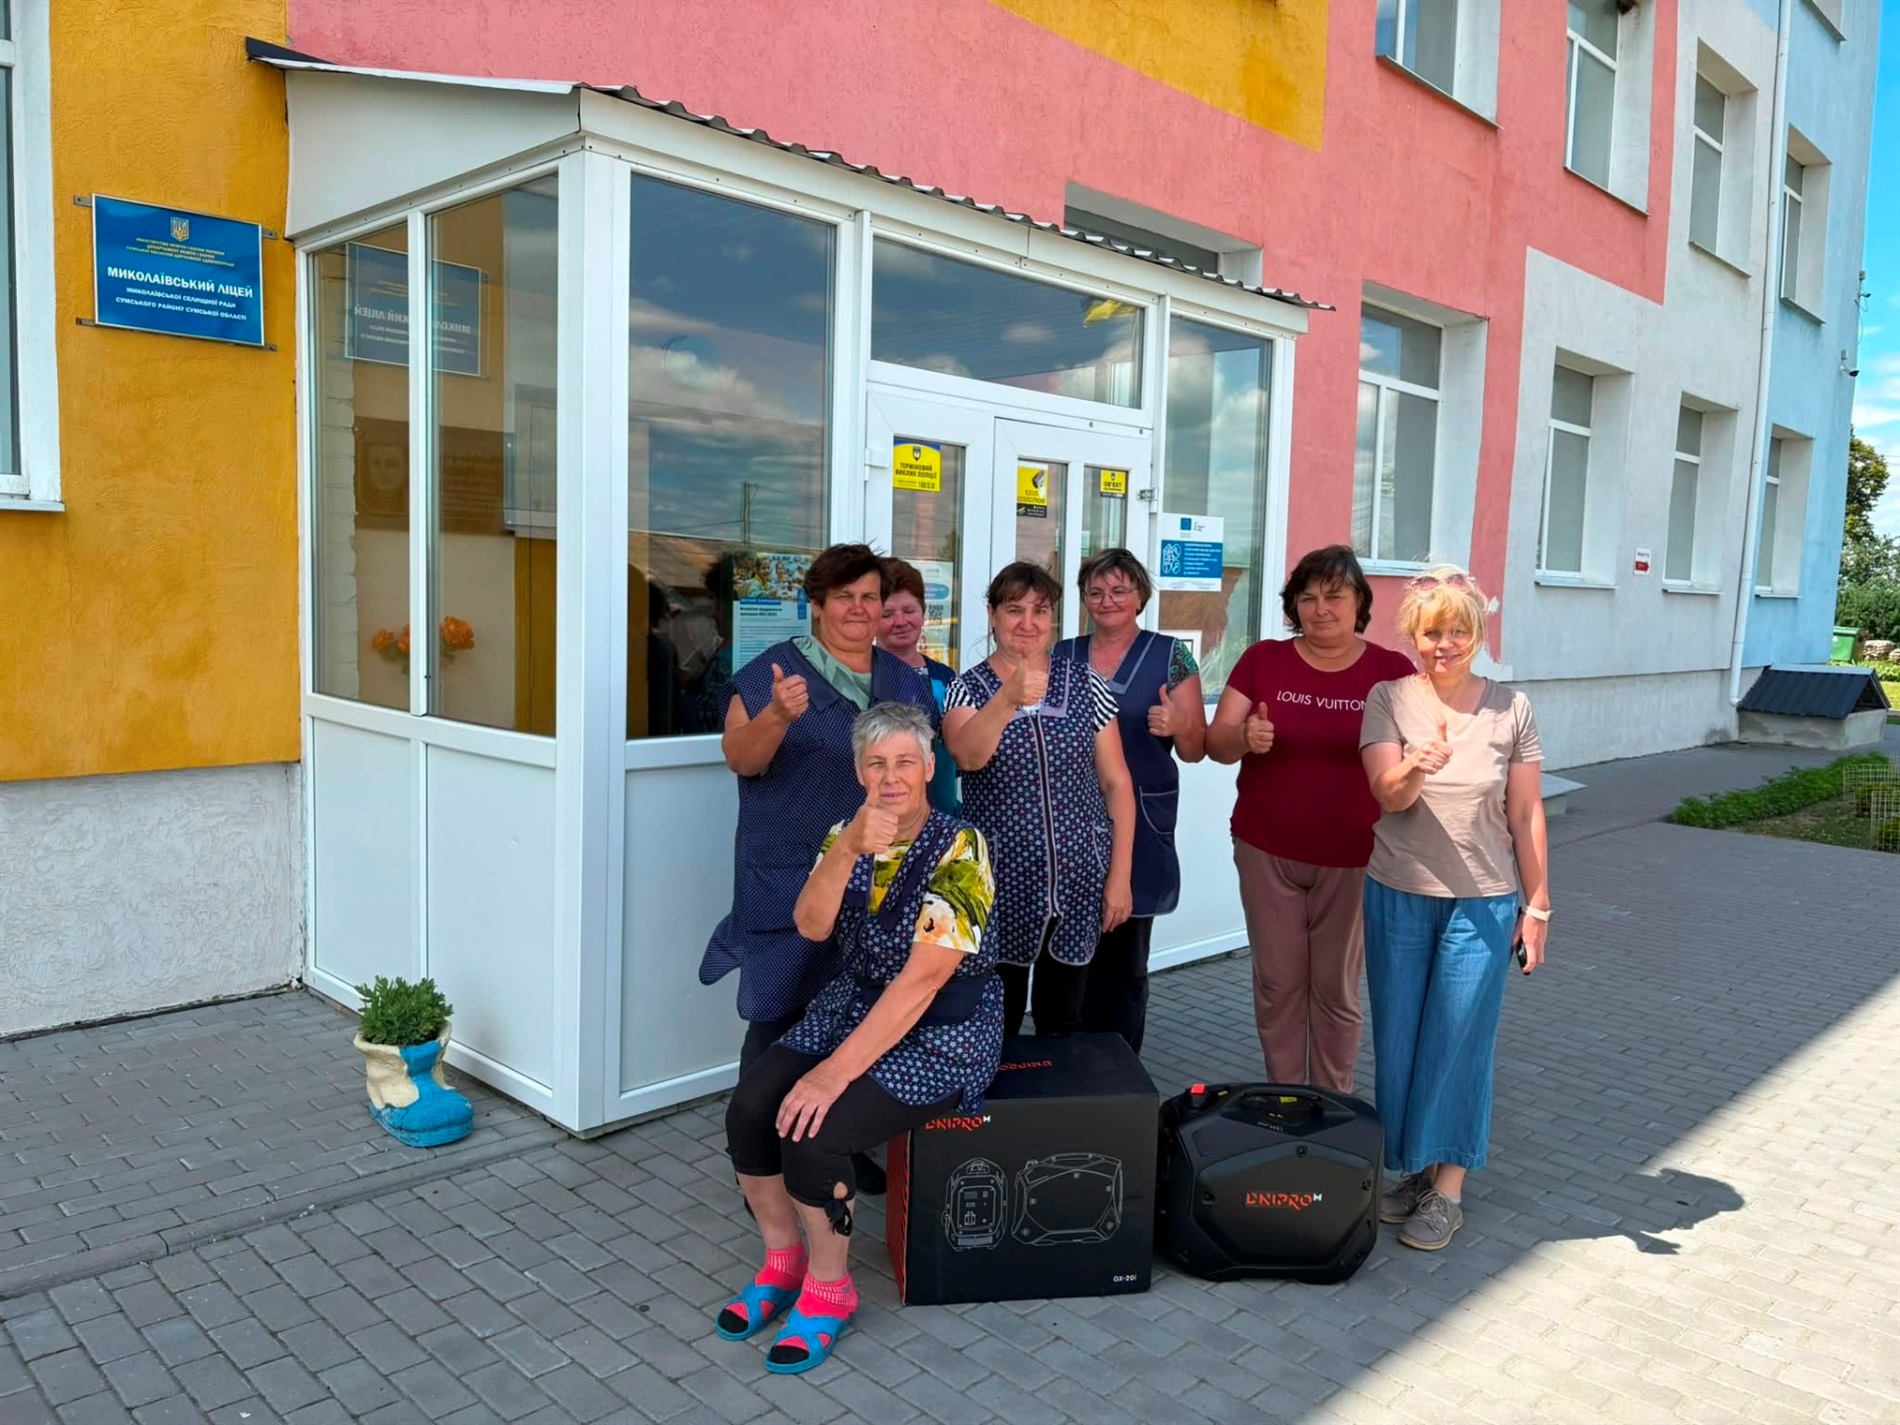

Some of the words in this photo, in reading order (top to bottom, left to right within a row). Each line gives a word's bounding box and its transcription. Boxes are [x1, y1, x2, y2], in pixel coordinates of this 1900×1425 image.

[108, 266, 215, 293] МИКОЛАЇВСЬКИЙ
[217, 285, 253, 298] ЛІЦЕЙ
[116, 296, 157, 308] СУМСЬКОГО
[158, 301, 184, 312] РАЙОНУ
[186, 306, 219, 318] СУМСЬКОЇ
[220, 312, 247, 321] ОБЛАСТІ
[126, 287, 182, 300] МИКОЛАЇВСЬКОЇ
[183, 294, 218, 307] СЕЛИЩНОЇ
[219, 300, 236, 308] РАДИ
[1276, 690, 1312, 706] LOUIS
